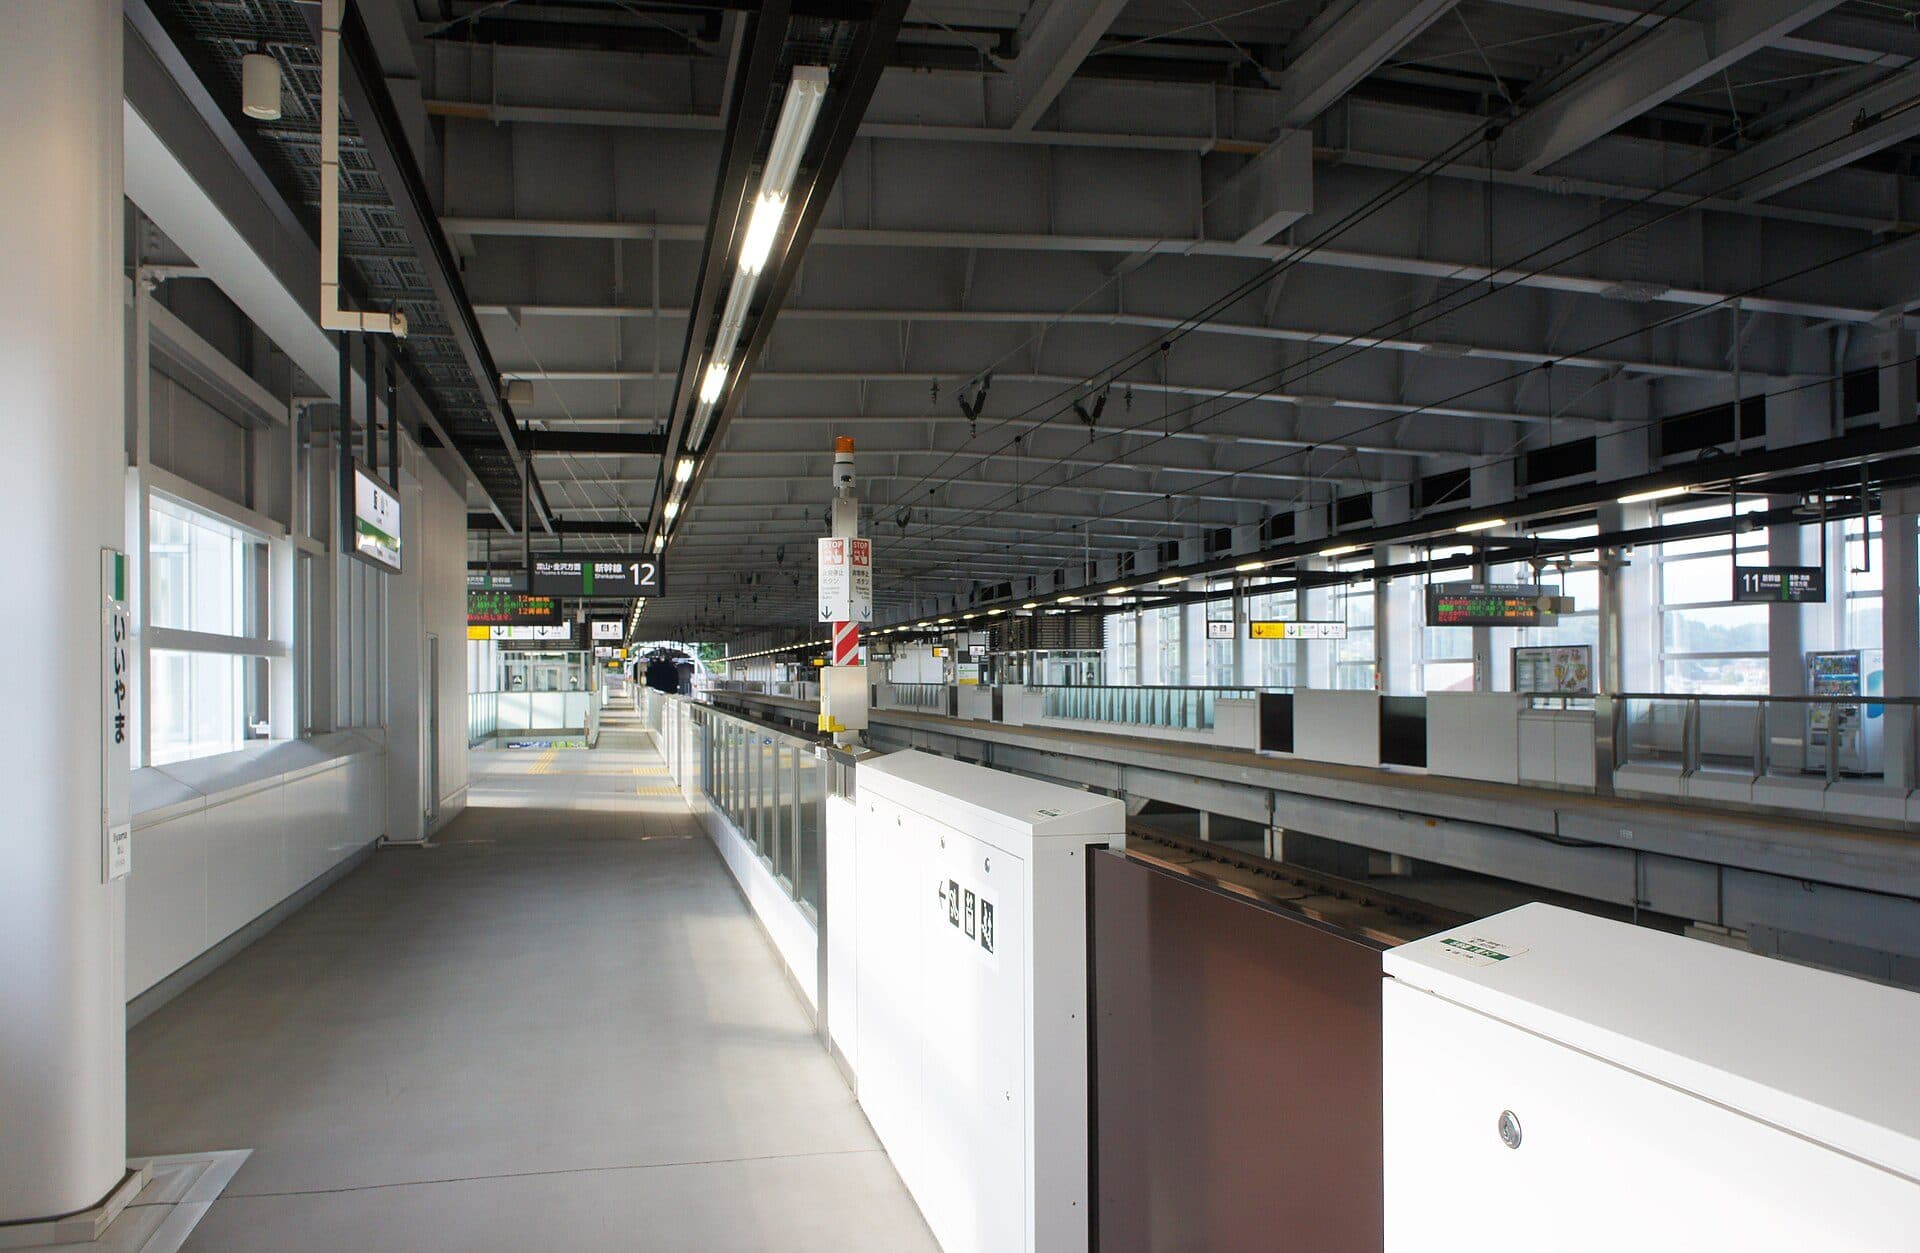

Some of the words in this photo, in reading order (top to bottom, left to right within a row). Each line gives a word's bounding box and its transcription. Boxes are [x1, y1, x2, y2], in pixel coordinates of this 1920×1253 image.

[594, 563, 623, 573] 新幹線
[629, 563, 656, 586] 12
[1743, 573, 1759, 593] 11
[114, 614, 126, 744] いいやま
